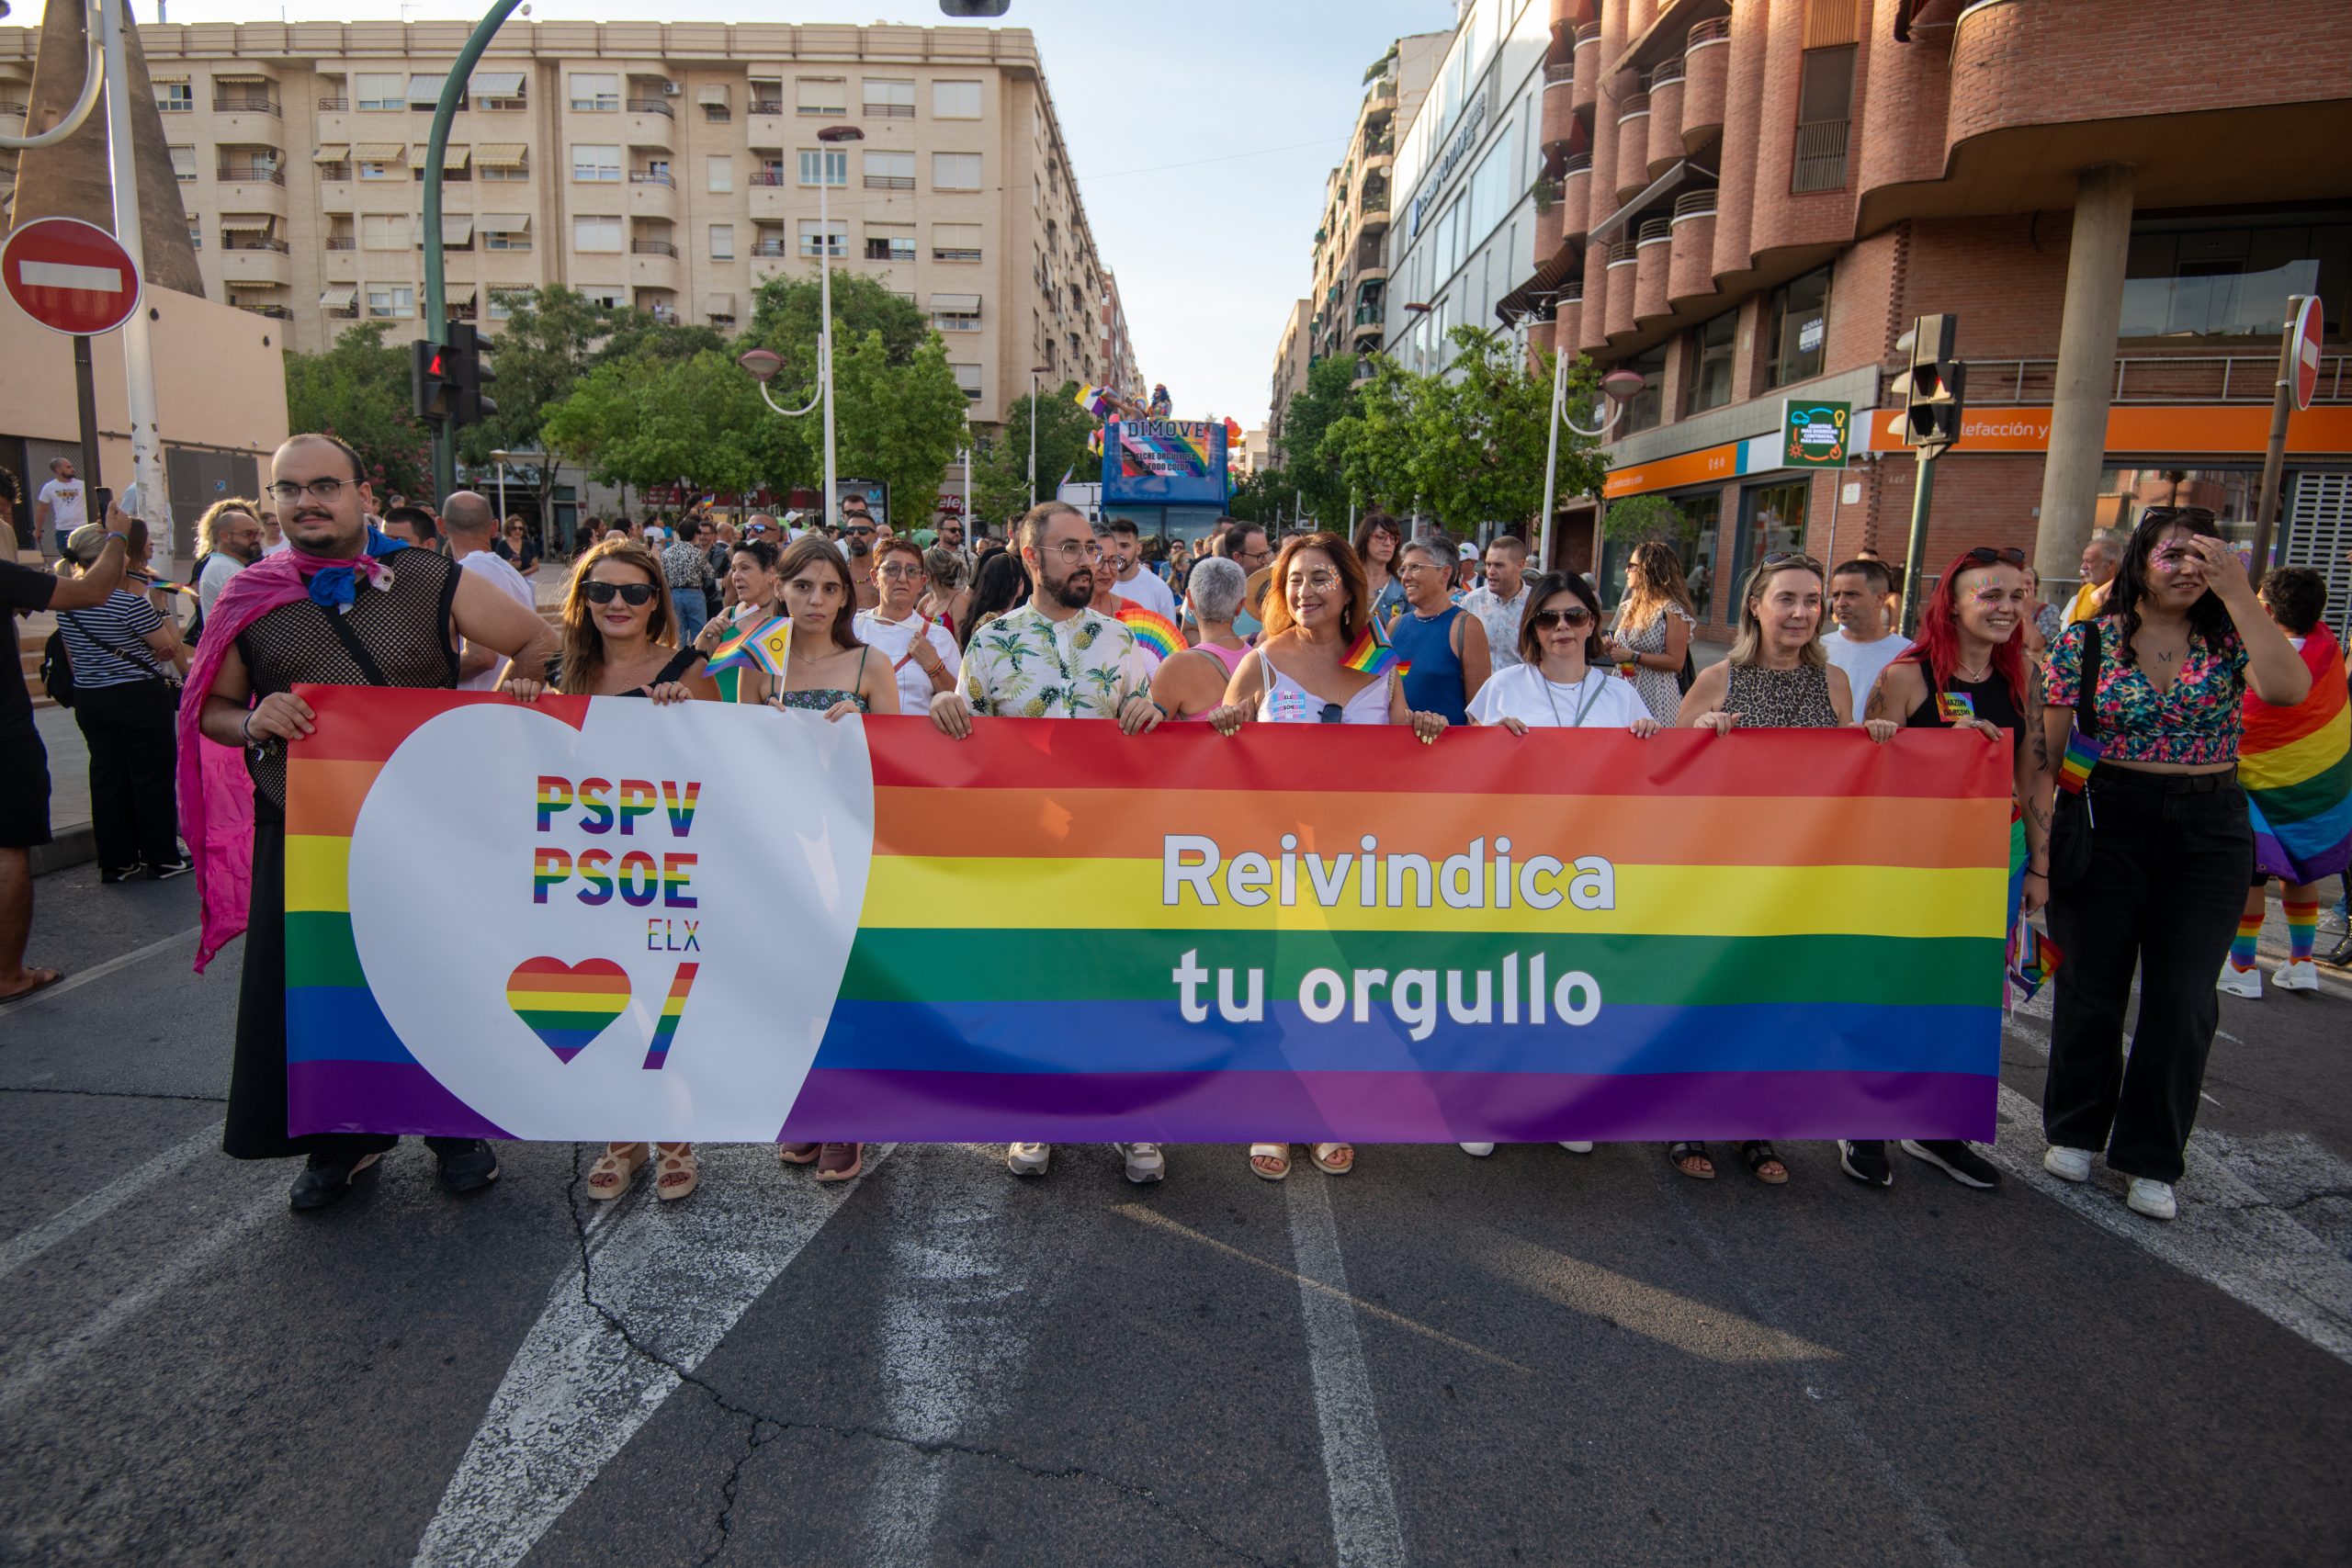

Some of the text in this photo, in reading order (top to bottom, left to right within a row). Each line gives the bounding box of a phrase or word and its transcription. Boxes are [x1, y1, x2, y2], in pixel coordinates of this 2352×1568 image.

[1127, 422, 1205, 437] DIMOVE
[1961, 422, 2049, 439] lefacción y
[537, 775, 702, 838] PSPV
[533, 847, 698, 909] PSOE
[1162, 833, 1615, 910] Reivindica
[648, 919, 700, 952] ELX
[1171, 947, 1602, 1042] tu orgullo
